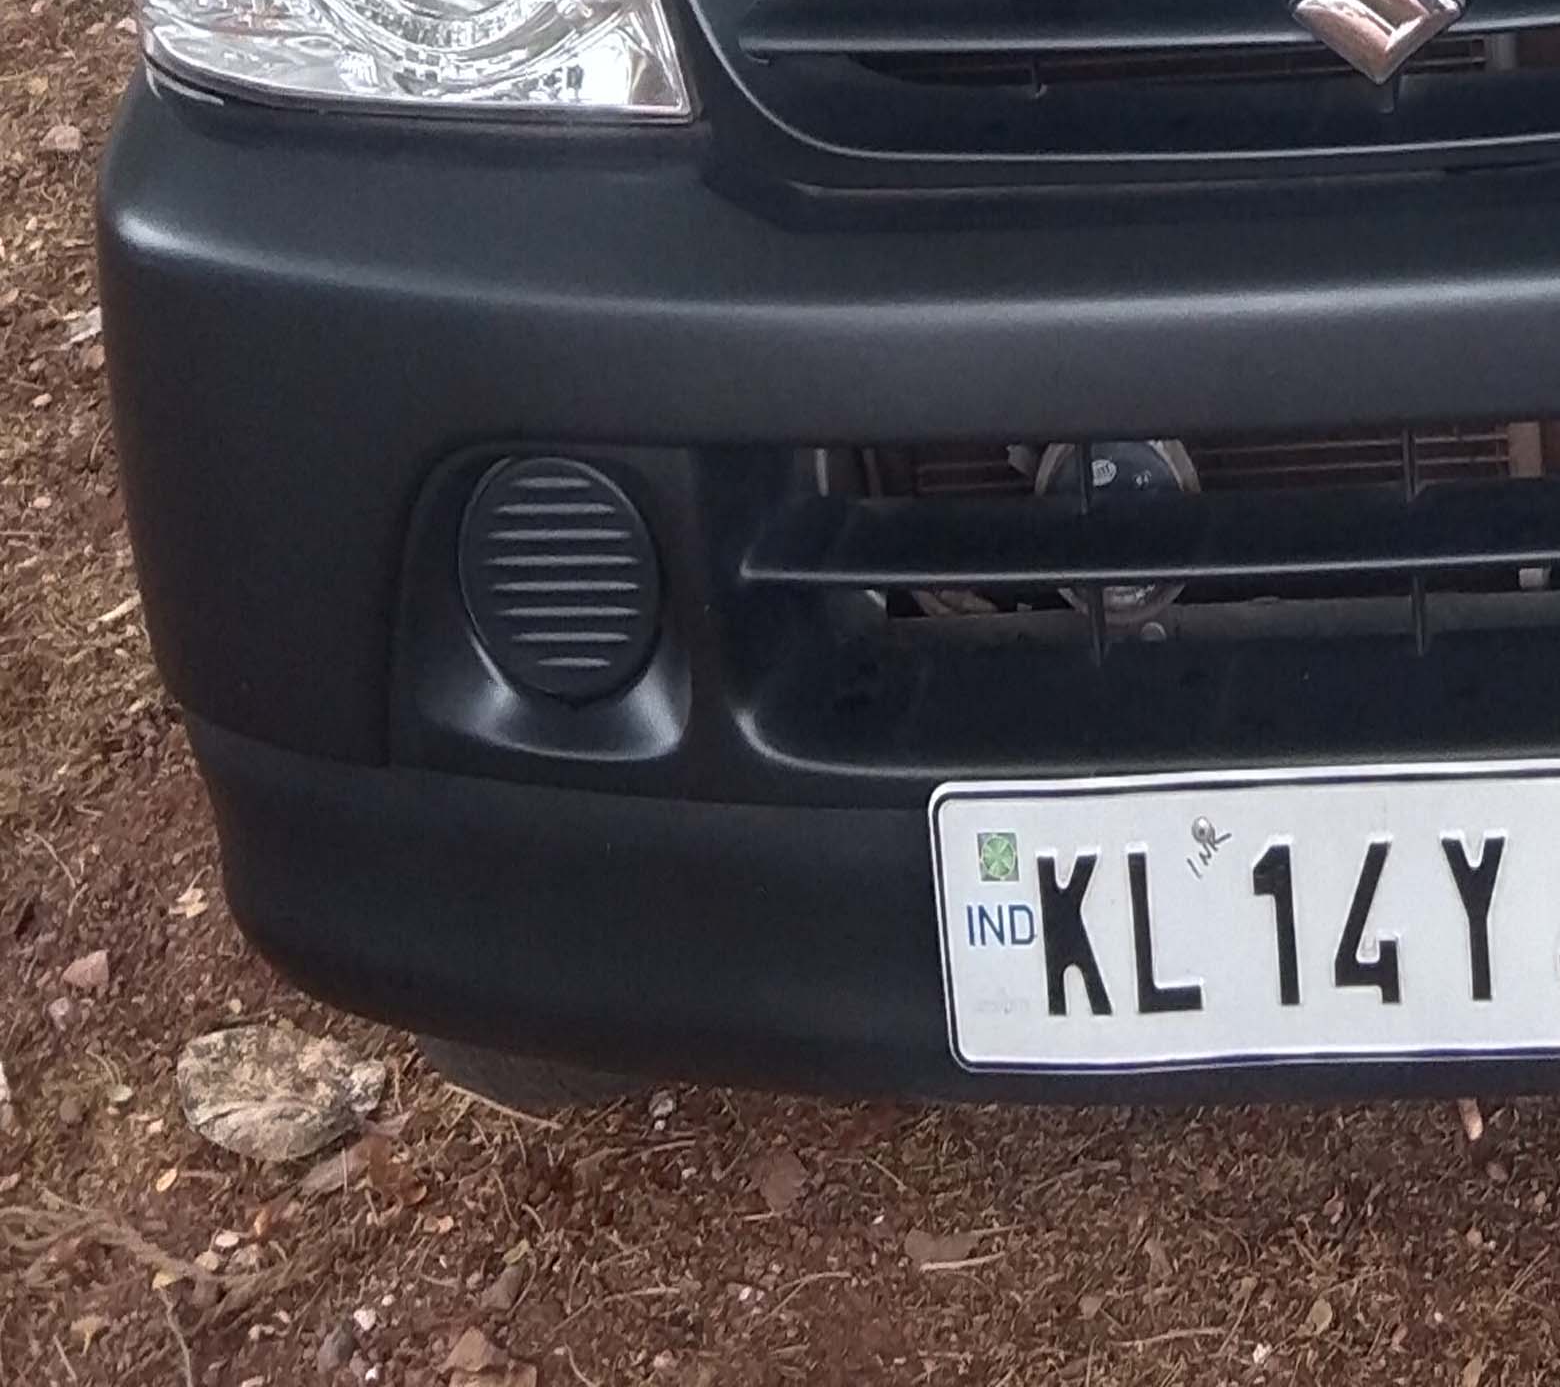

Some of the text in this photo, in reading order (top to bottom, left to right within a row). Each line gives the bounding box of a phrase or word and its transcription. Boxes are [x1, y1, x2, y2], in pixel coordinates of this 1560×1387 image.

[966, 903, 1037, 947] IND
[1036, 851, 1203, 1017] KL
[1252, 839, 1400, 1006] 14
[1442, 836, 1506, 1001] Y
